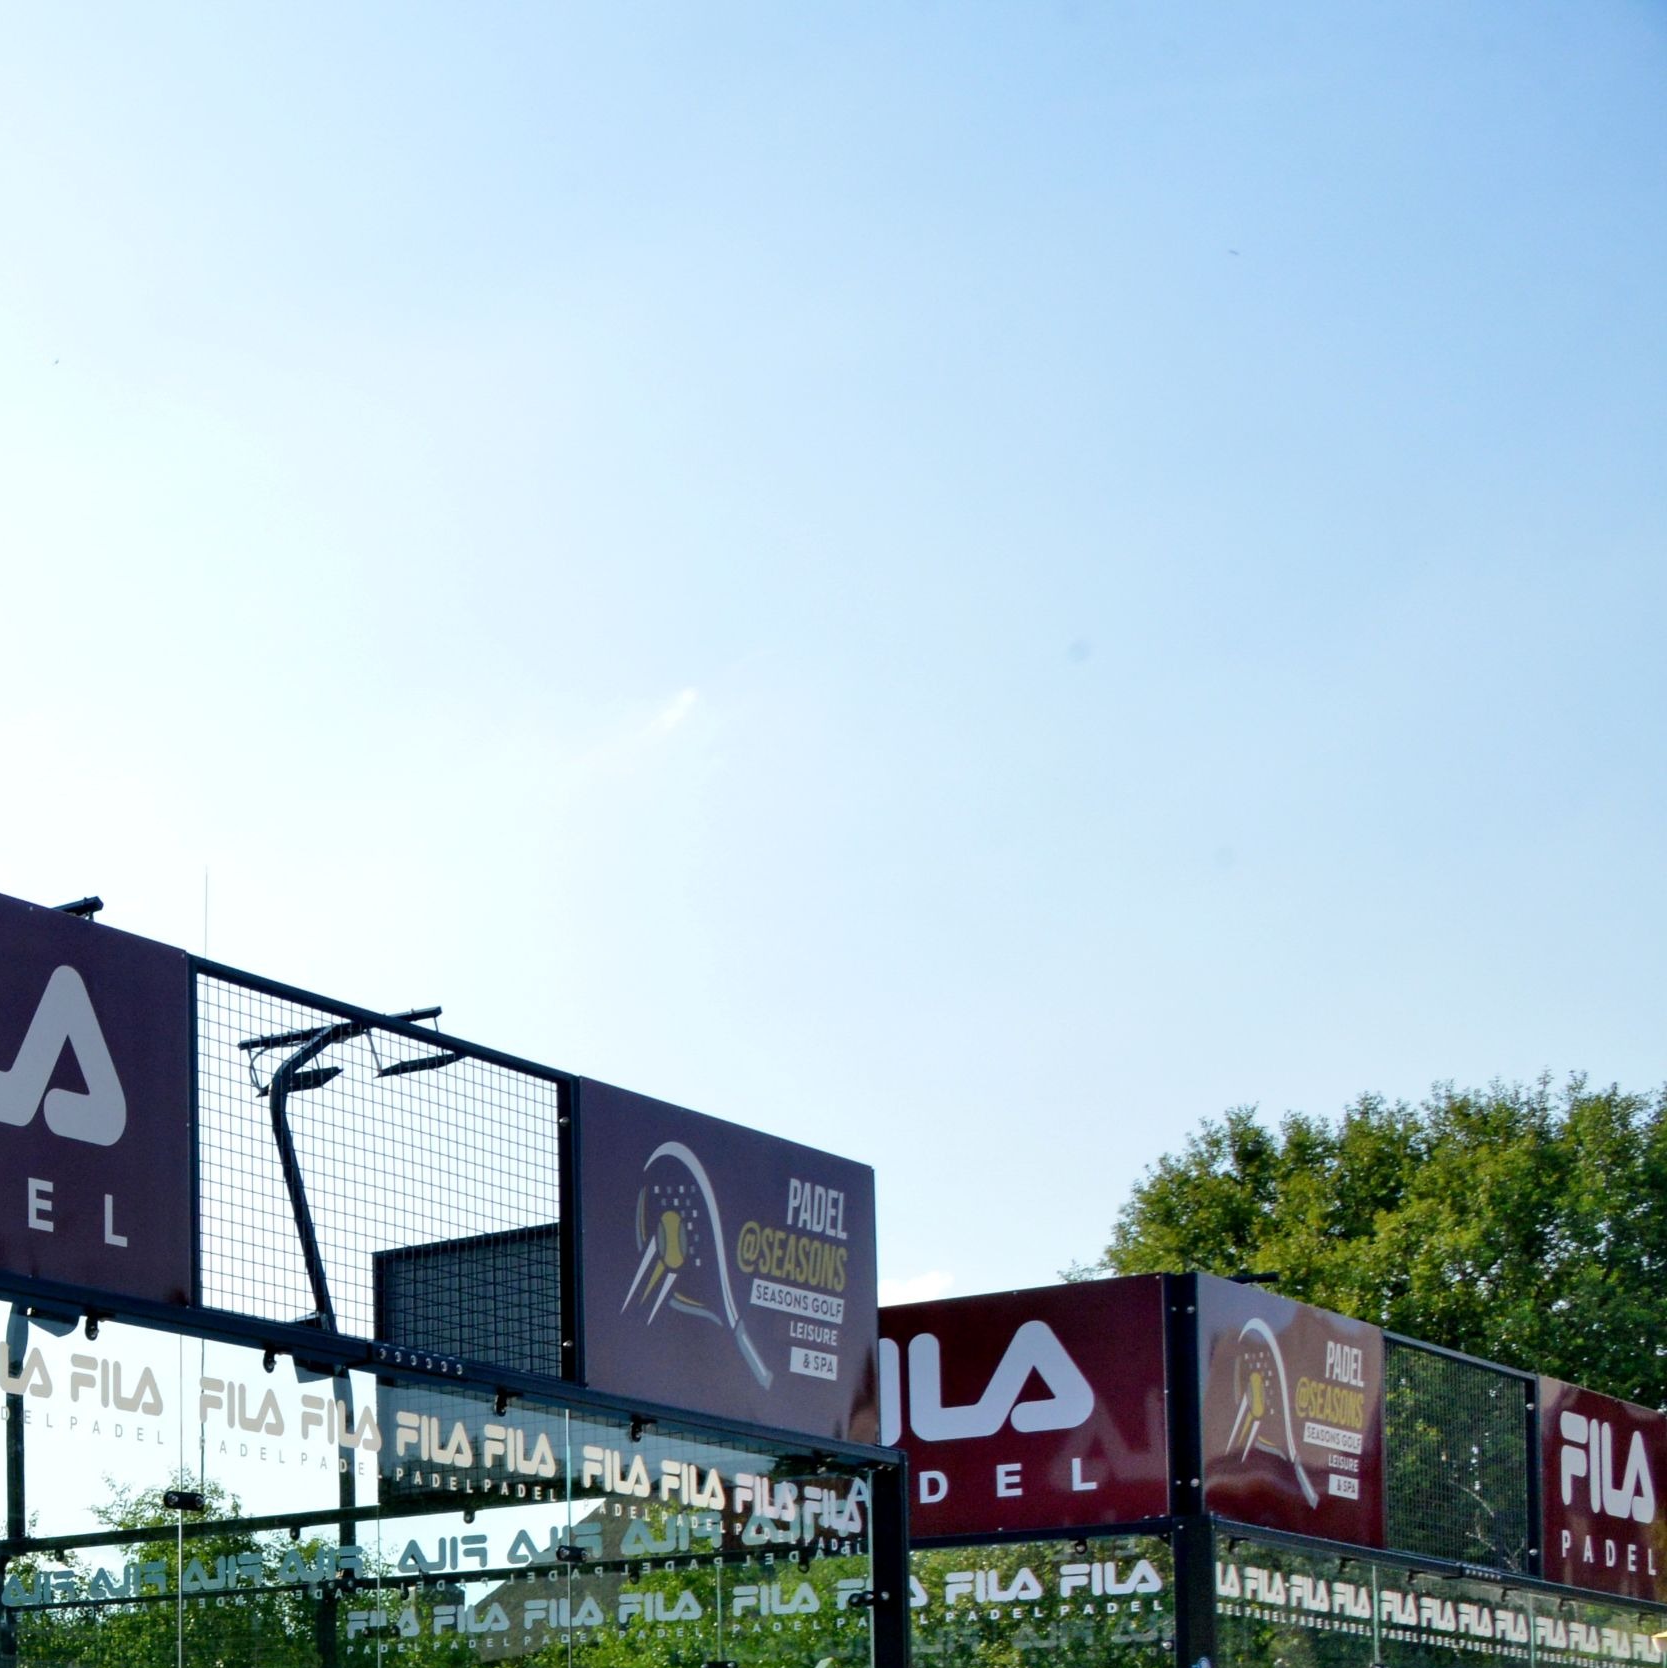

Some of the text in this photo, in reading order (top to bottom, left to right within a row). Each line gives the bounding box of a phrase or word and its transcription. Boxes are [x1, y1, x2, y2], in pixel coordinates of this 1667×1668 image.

[787, 1178, 848, 1240] PADEL
[737, 1221, 848, 1292] @SEASONS
[756, 1284, 843, 1319] SEASONS GOLF
[790, 1321, 837, 1346] LEISURE
[70, 1353, 163, 1416] FILA
[803, 1353, 834, 1374] & SPA
[879, 1320, 1094, 1447] ILA
[1326, 1342, 1364, 1387] PADEL
[1296, 1377, 1363, 1427] @SEASONS
[70, 1416, 163, 1445] PADEL
[200, 1376, 556, 1477] FILA FILA FILA FILA
[1307, 1426, 1361, 1450] SEASONS GOLF
[583, 1445, 651, 1497] FILA
[661, 1459, 725, 1511] FILA
[1328, 1454, 1358, 1471] LEISURE
[1560, 1411, 1655, 1523] FILA
[1344, 1480, 1356, 1494] SPA
[1562, 1529, 1656, 1575] PADEL
[945, 1559, 1163, 1605] FILA FILA
[1244, 1566, 1373, 1619] FILA FILA FILA
[433, 1602, 510, 1634] FILA
[524, 1596, 604, 1630] FILA
[619, 1590, 702, 1623] FILA
[733, 1583, 820, 1617] FILA
[733, 1621, 820, 1635] PADEL
[946, 1600, 1163, 1623] PADEL PADEL
[1381, 1590, 1529, 1644] FILA FILA FILA FILA
